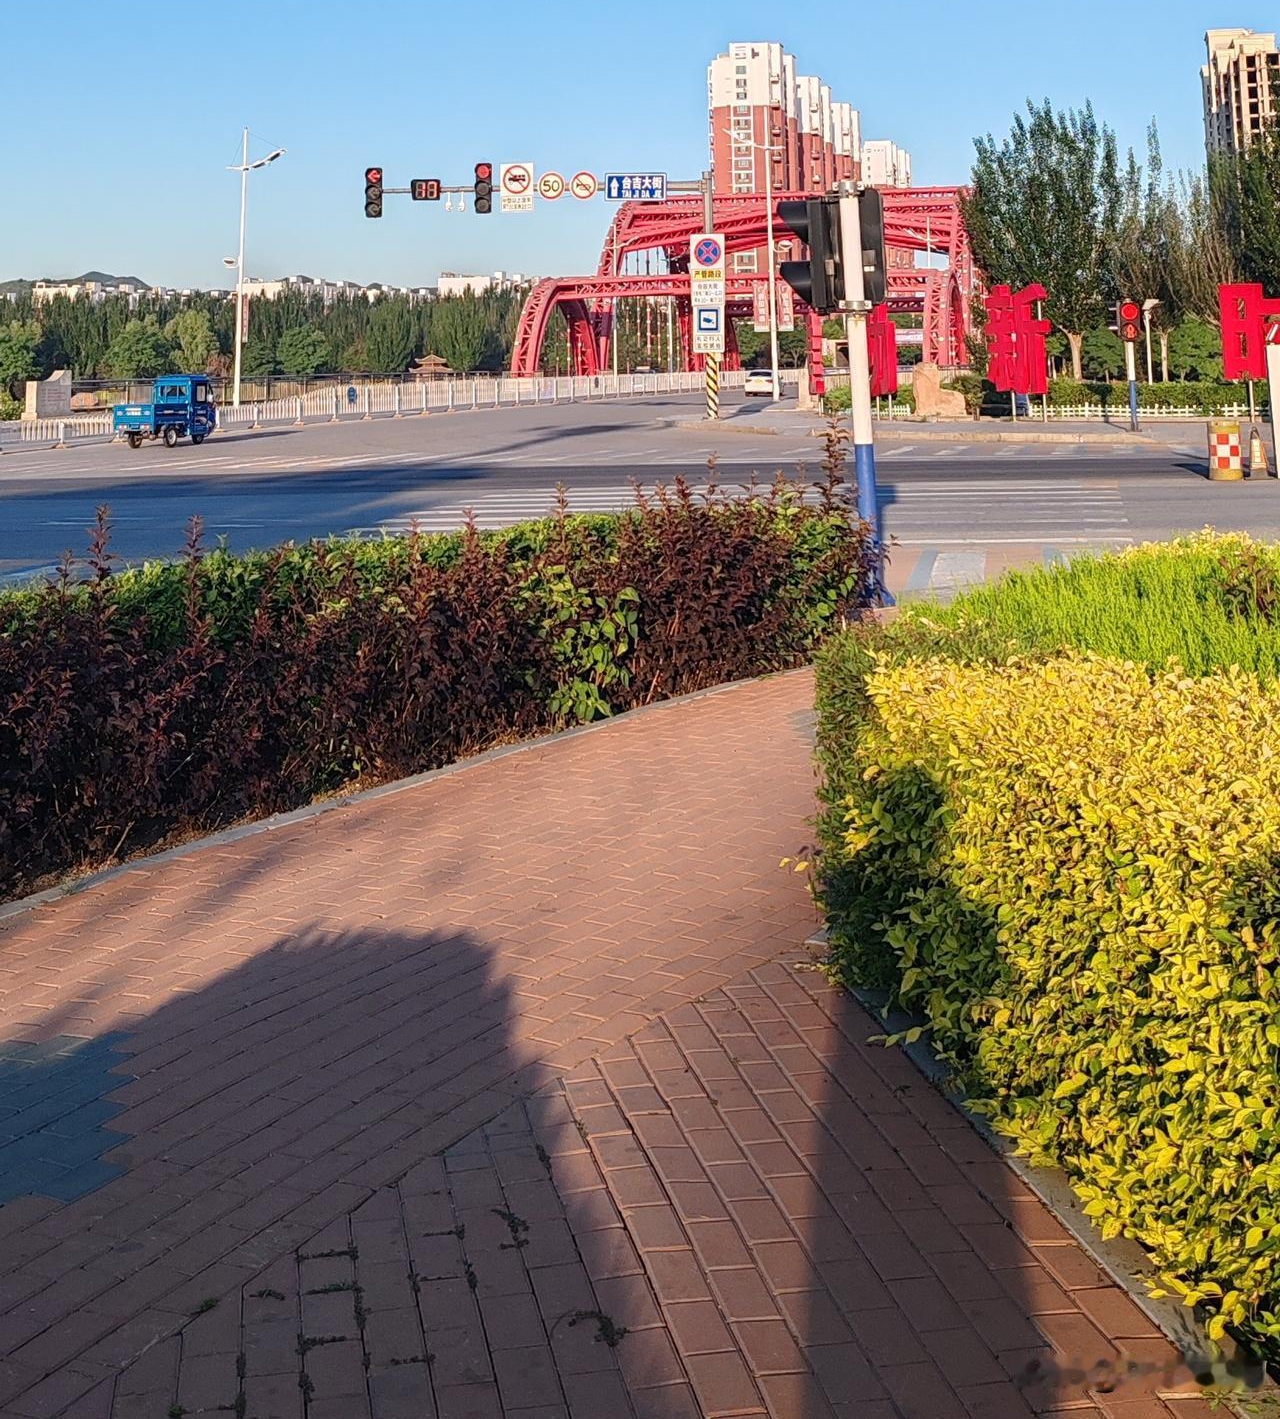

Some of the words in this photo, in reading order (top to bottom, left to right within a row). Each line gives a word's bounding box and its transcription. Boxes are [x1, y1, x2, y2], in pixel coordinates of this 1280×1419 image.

[543, 180, 560, 192] 50
[622, 176, 662, 189] 台吉大街
